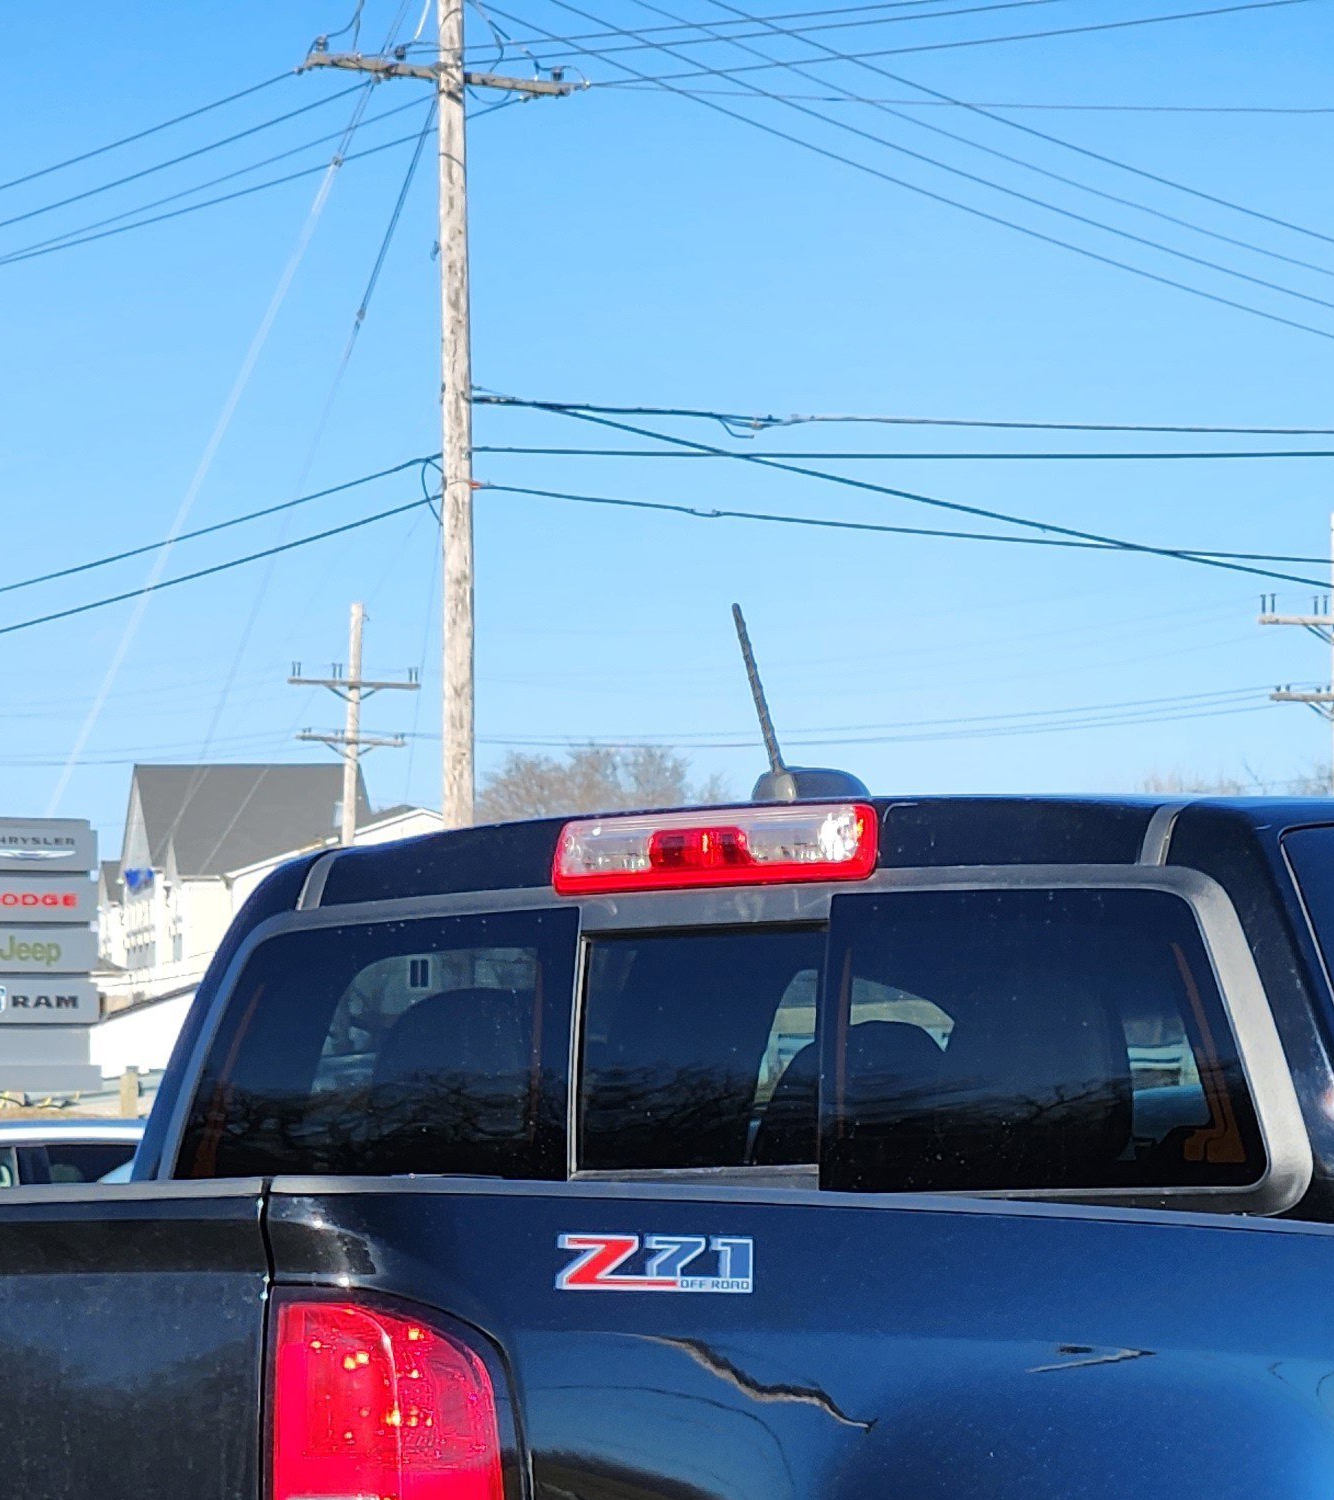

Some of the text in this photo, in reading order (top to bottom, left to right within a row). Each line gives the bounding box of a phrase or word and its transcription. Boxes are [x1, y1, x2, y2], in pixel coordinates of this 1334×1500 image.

[0, 936, 61, 965] Jeep
[11, 995, 78, 1009] RAM
[555, 1234, 753, 1293] Z71
[680, 1279, 750, 1290] OFF ROAD
